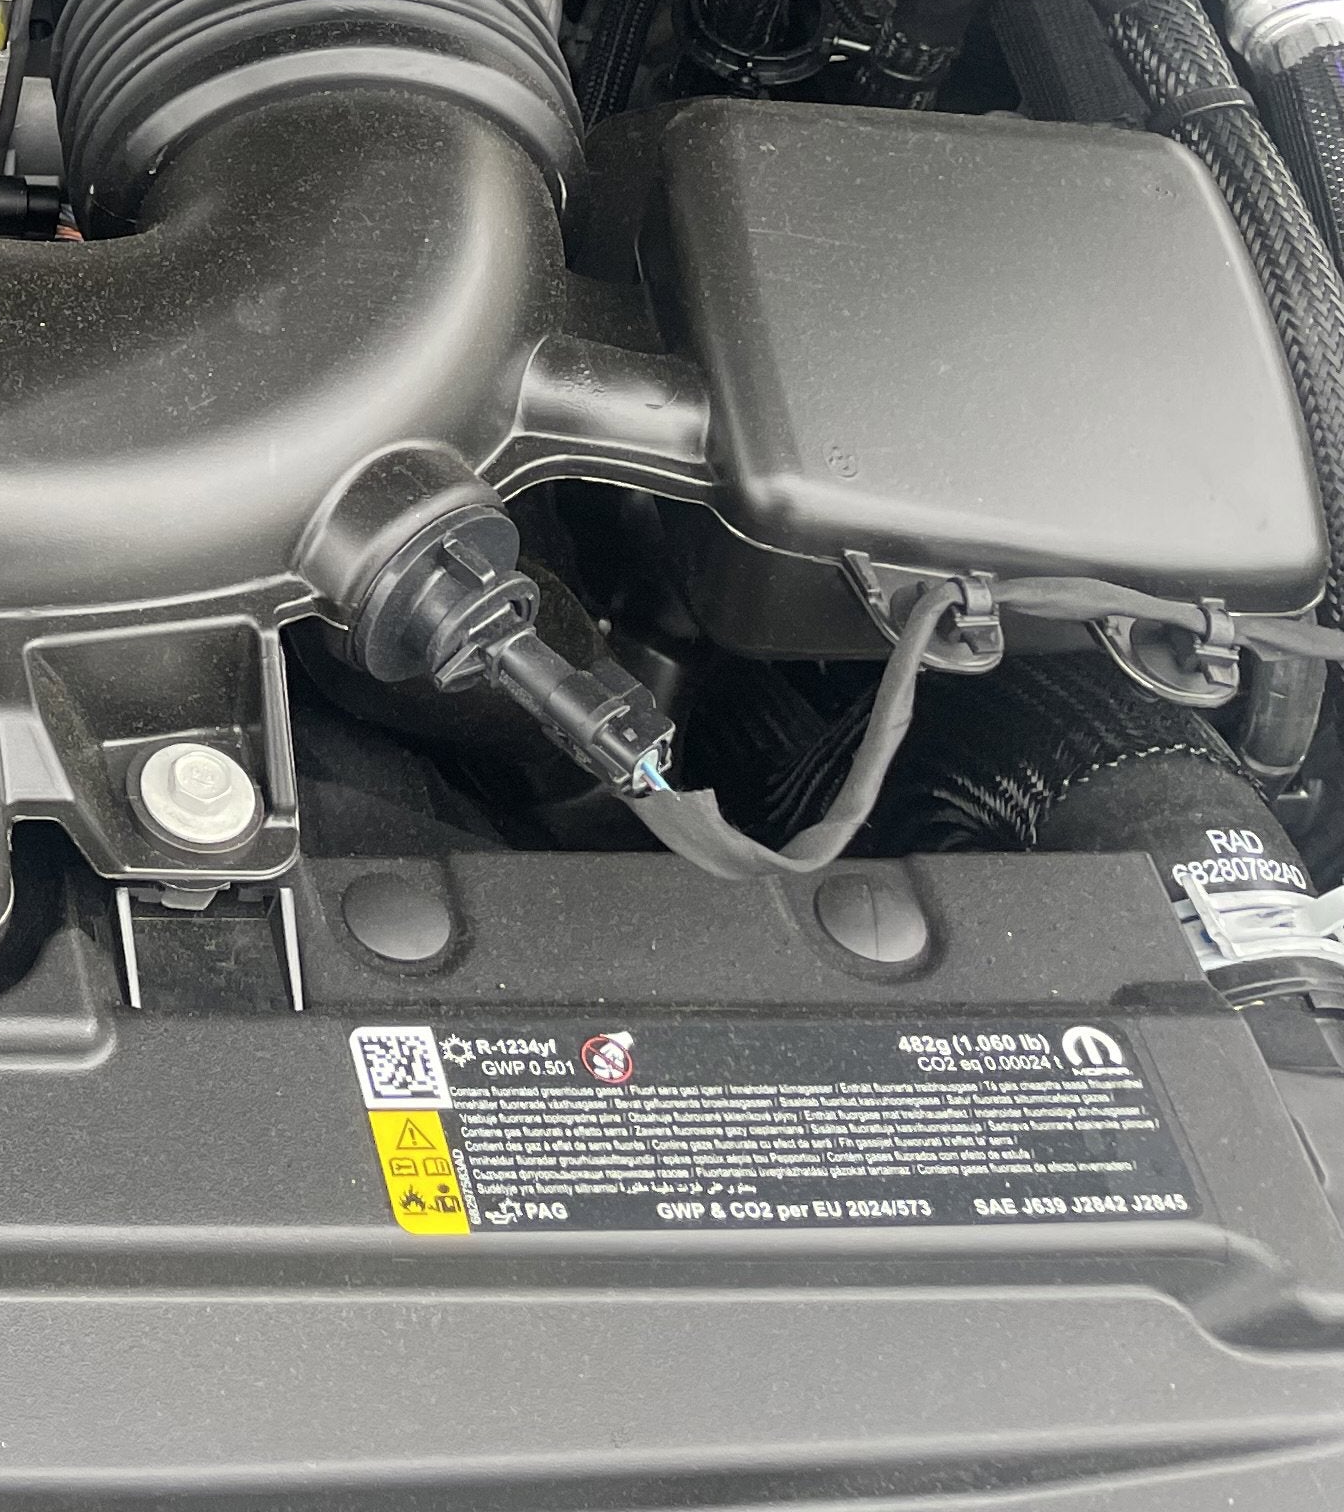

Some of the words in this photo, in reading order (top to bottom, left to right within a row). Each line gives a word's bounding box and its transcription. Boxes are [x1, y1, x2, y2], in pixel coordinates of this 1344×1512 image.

[1205, 829, 1264, 854] RAD
[1172, 857, 1307, 889] 68280782AD
[476, 1039, 556, 1058] R-1234yf
[898, 1035, 951, 1055] 482g
[952, 1034, 1017, 1055] (1.060
[1019, 1034, 1050, 1055] lb)
[481, 1061, 526, 1076] GWP
[529, 1060, 575, 1076] 0.501
[917, 1056, 957, 1071] CO2
[960, 1059, 984, 1074] eq
[984, 1055, 1051, 1071] 0.00024
[1054, 1056, 1063, 1070] t
[525, 1202, 568, 1220] PAG
[657, 1202, 705, 1220] GWP
[710, 1202, 727, 1219] &
[729, 1202, 774, 1219] CO2
[776, 1204, 809, 1221] per
[812, 1200, 843, 1218] EU
[845, 1199, 932, 1218] 2024/573
[973, 1198, 1018, 1216] SAE
[1022, 1197, 1067, 1215] J639
[1071, 1195, 1128, 1214] J2842
